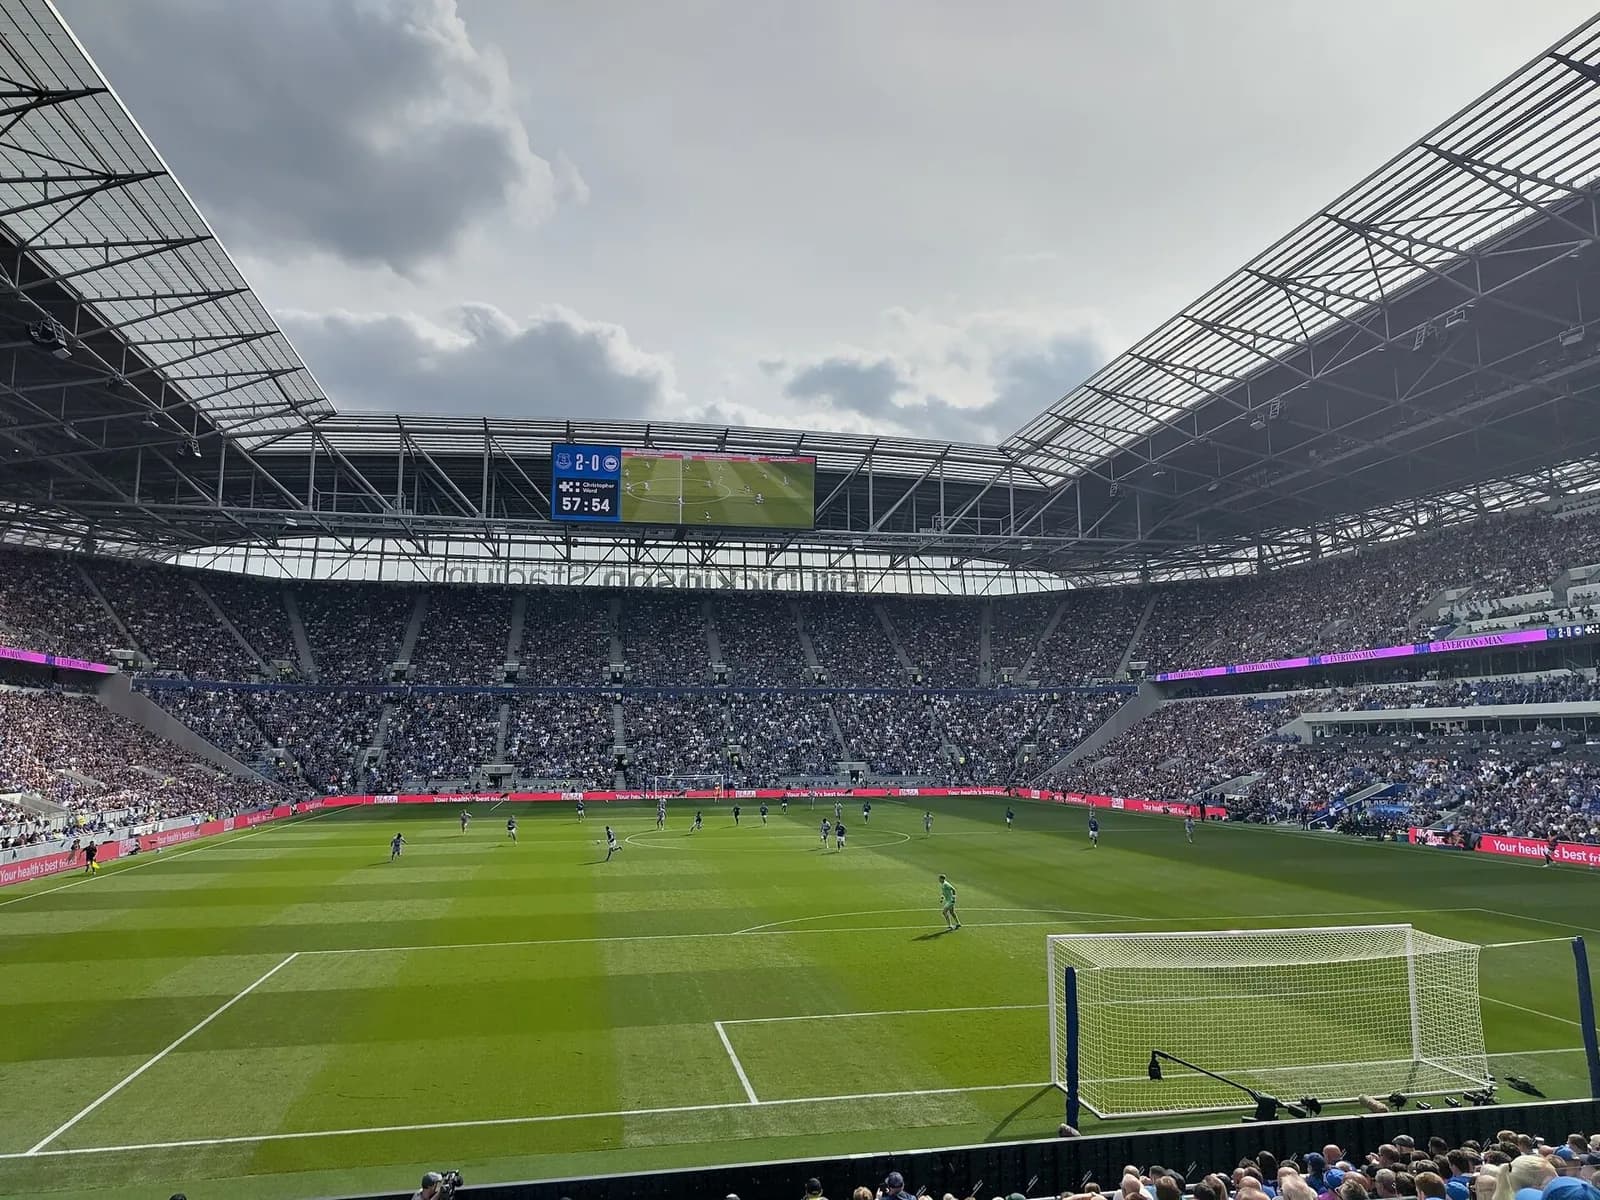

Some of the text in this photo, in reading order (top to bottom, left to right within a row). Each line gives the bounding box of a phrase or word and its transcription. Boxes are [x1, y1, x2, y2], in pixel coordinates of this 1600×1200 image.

[576, 453, 599, 471] 2-0
[562, 496, 610, 512] 57:54
[1442, 638, 1479, 650] EVERTON
[433, 795, 448, 803] Your
[1493, 839, 1517, 851] Your
[1518, 841, 1560, 858] healths
[1562, 847, 1587, 861] best
[0, 868, 17, 882] Your
[17, 861, 44, 879] health's
[45, 858, 58, 872] best
